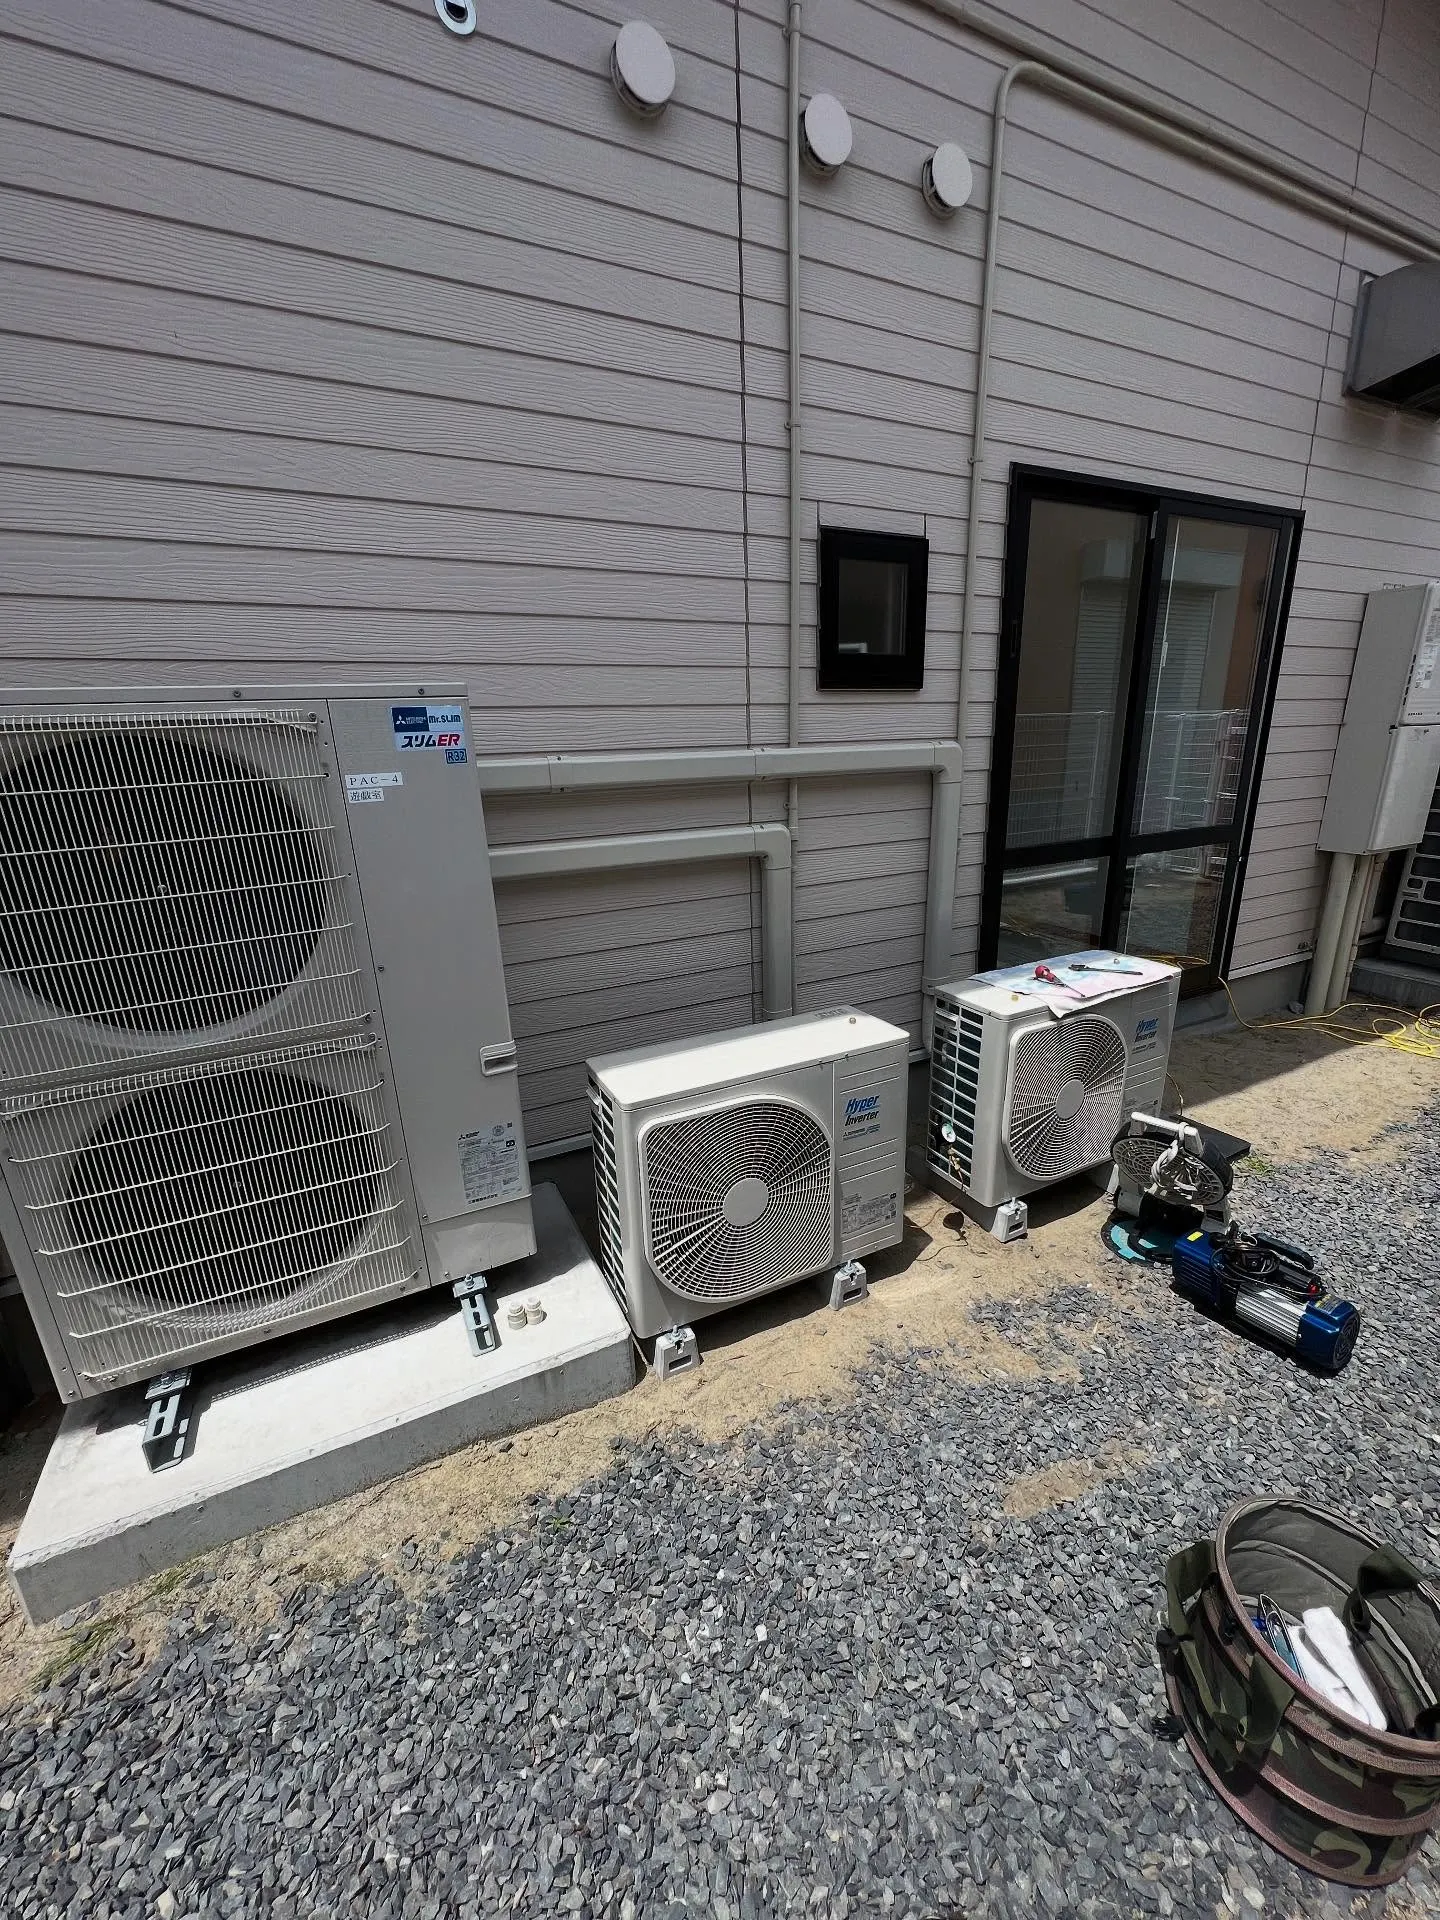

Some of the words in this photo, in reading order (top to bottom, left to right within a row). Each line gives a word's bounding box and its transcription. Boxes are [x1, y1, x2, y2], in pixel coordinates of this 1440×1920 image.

[447, 750, 466, 762] R32
[845, 1095, 880, 1114] Hyper
[844, 1111, 879, 1126] Inverter
